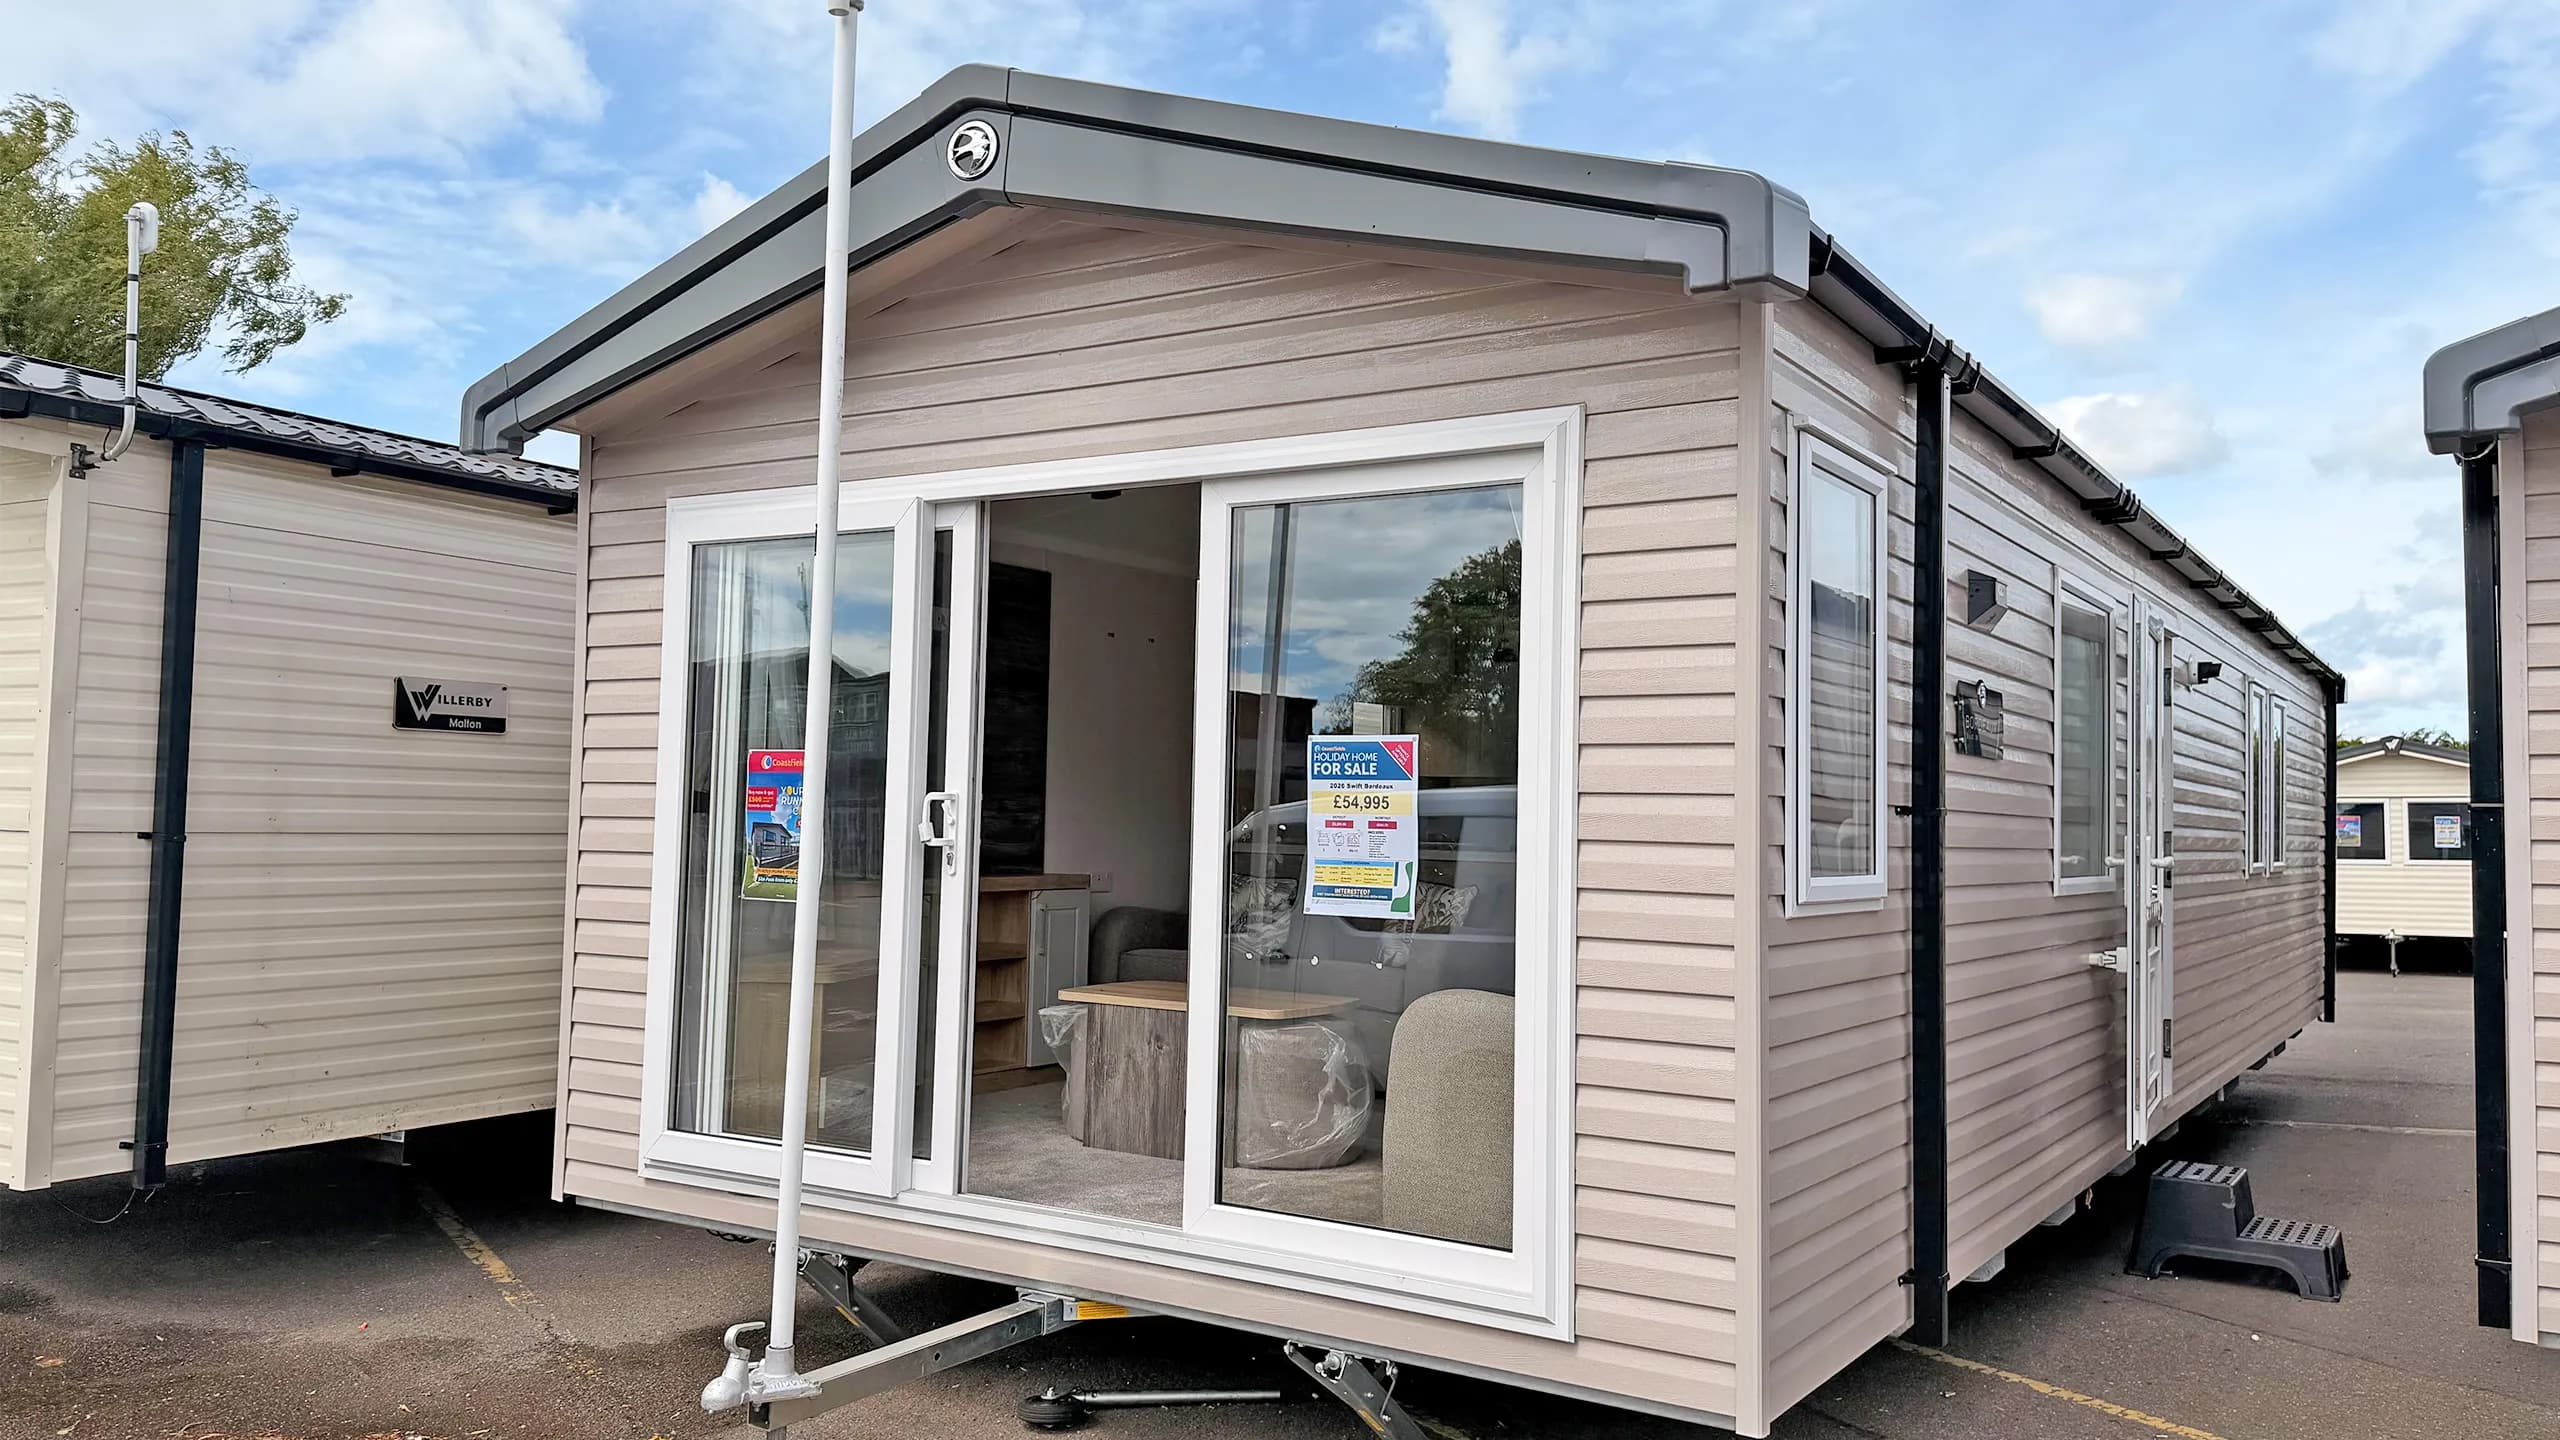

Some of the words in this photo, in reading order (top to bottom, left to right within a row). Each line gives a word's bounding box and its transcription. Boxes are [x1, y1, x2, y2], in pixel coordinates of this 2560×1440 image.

[410, 684, 493, 712] WILLERBY
[449, 718, 482, 729] Malton
[1313, 753, 1350, 762] HOLIDAY
[1352, 753, 1378, 762] HOME
[1313, 763, 1342, 775] FOR
[1344, 763, 1378, 775] SALE
[1333, 795, 1389, 811] £54,995
